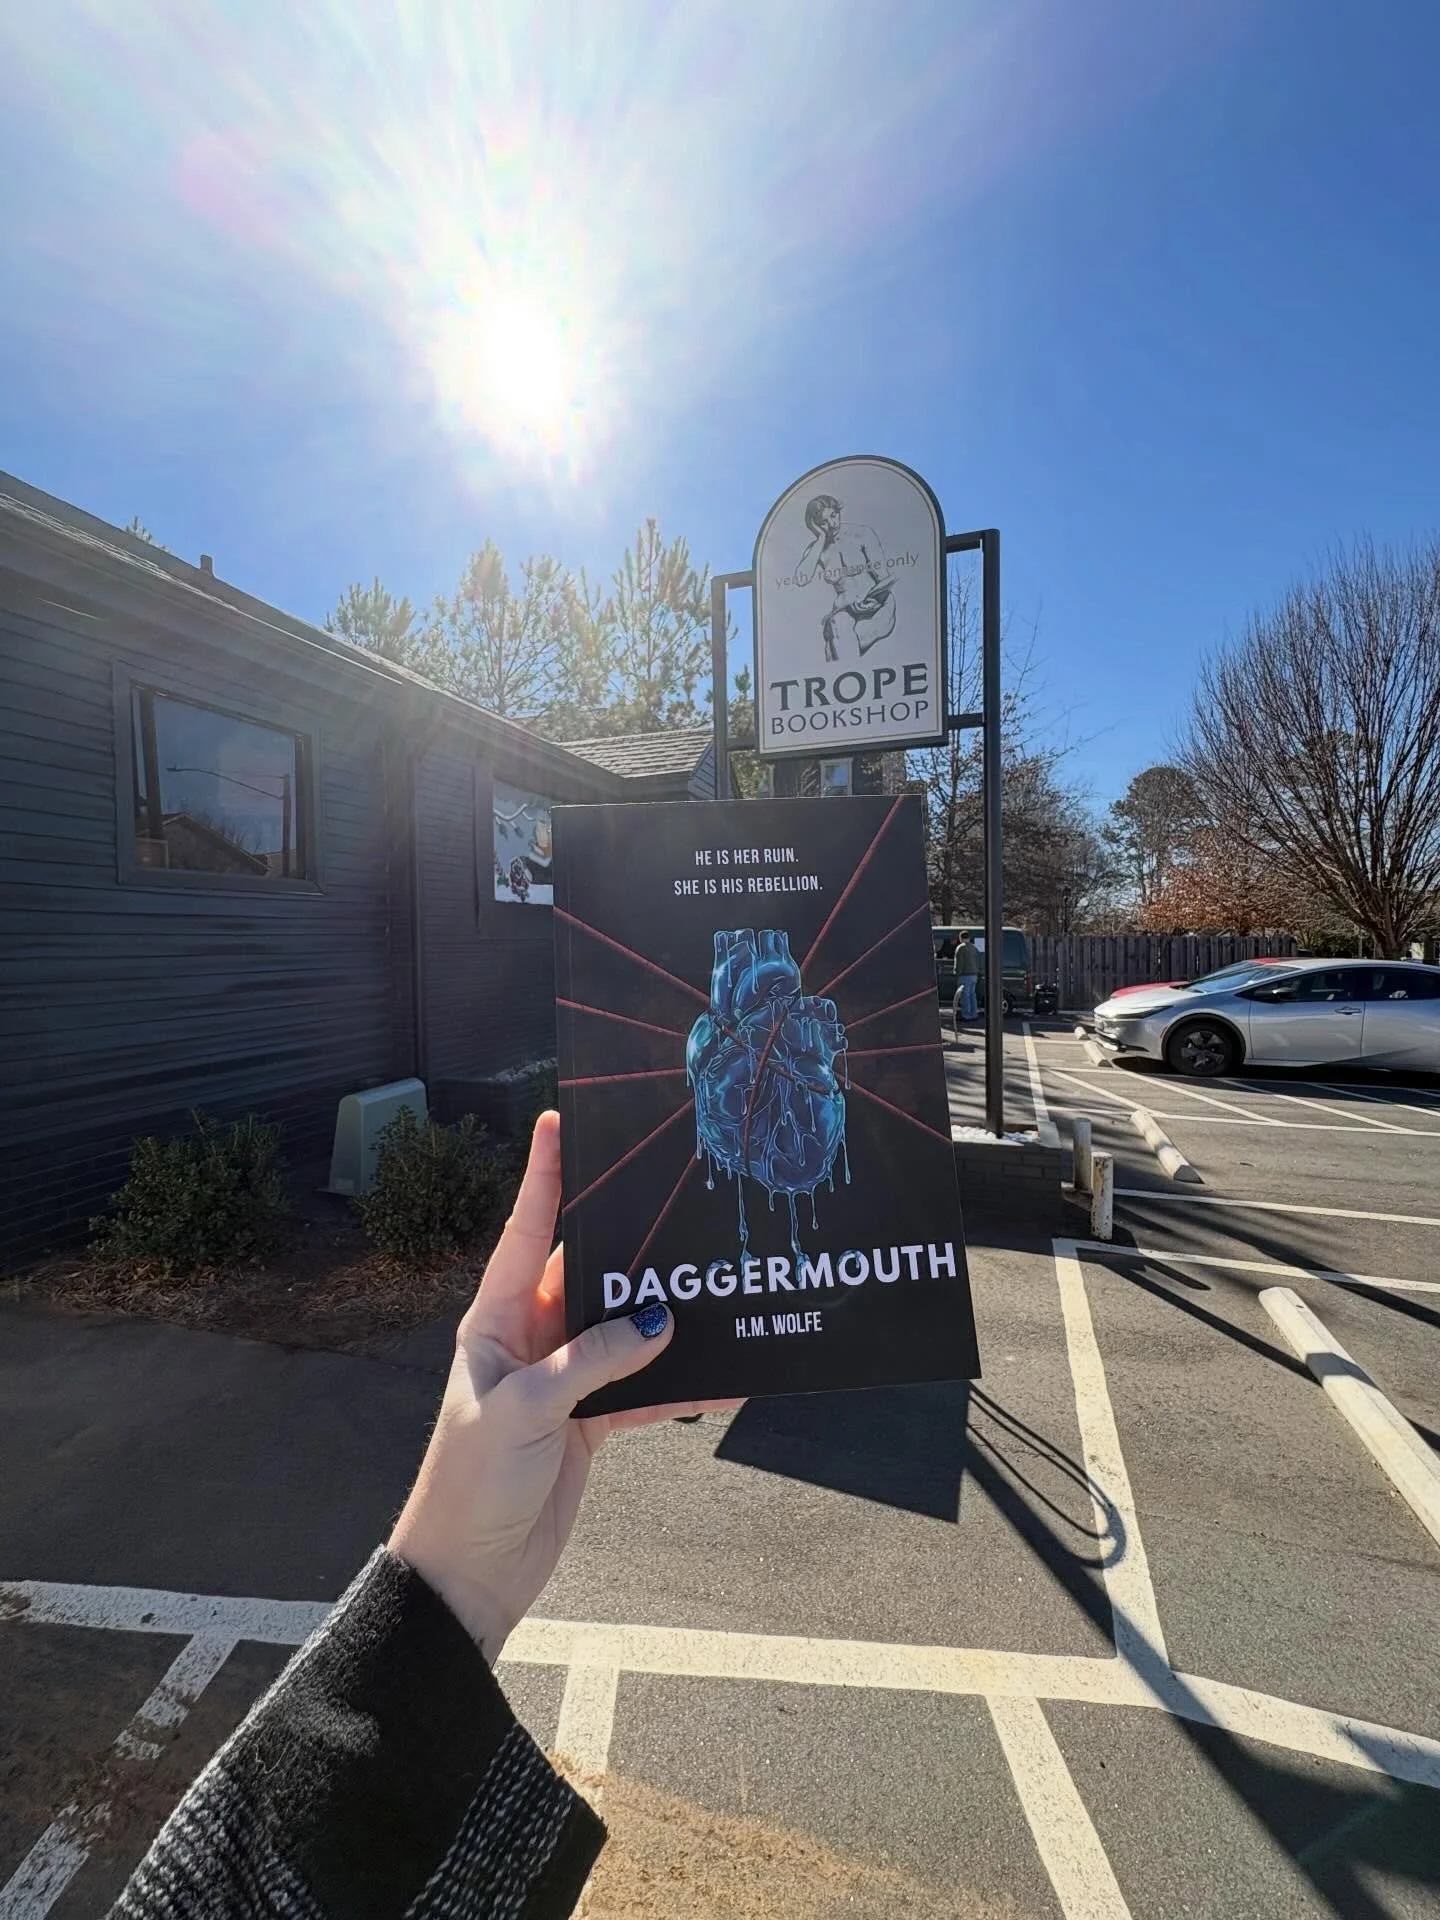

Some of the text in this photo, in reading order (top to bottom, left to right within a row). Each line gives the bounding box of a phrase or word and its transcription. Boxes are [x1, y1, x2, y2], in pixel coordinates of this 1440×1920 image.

[886, 552, 919, 568] only
[770, 663, 928, 711] TROPE
[772, 700, 928, 735] BOOKSHOP
[695, 847, 799, 866] HE IS HER RUIN.
[674, 875, 823, 895] SHE IS HIS REBELLION.
[603, 1242, 956, 1308] DAGGERMOUTH
[735, 1311, 822, 1338] H.M. WOLFE
